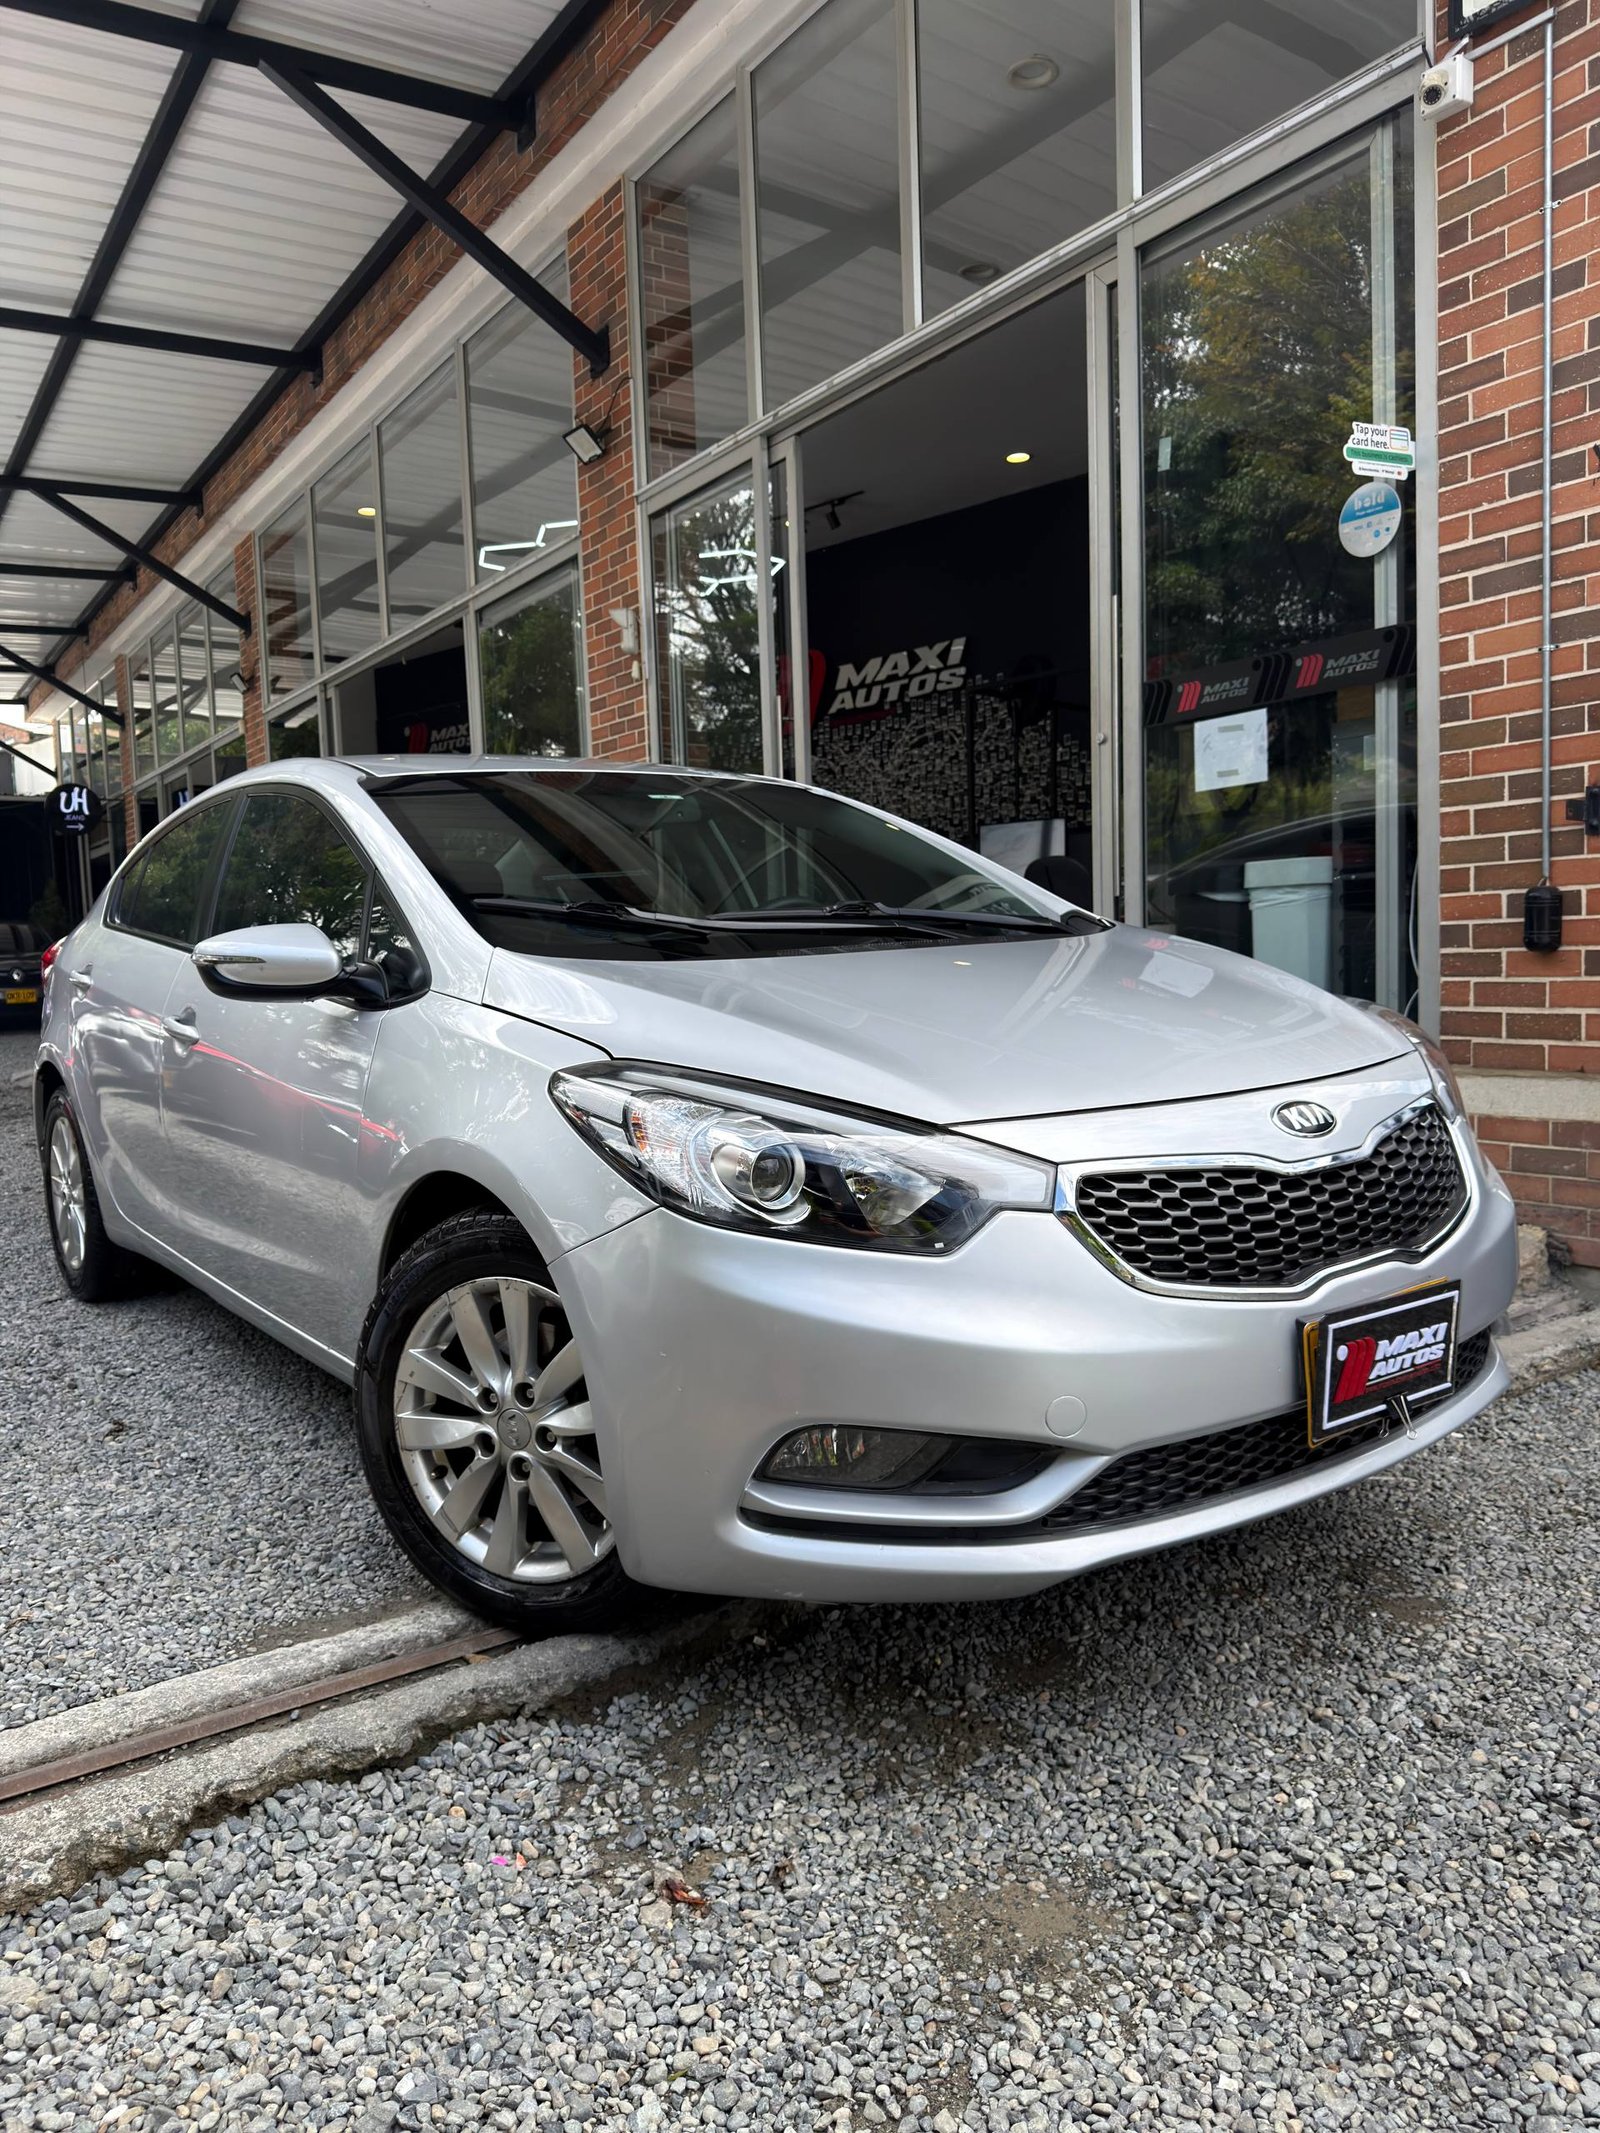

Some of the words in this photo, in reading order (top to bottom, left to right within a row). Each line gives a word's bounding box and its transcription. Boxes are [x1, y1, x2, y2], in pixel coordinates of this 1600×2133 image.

[1355, 423, 1369, 436] Tap
[1371, 427, 1388, 437] your
[1351, 437, 1369, 447] card
[1370, 438, 1390, 450] here.
[834, 636, 967, 692] MAXI
[1325, 649, 1381, 669] MAXI
[1323, 660, 1379, 679] AUTOS
[827, 666, 967, 715] AUTOS
[1201, 687, 1249, 704] AUTOS
[1203, 677, 1250, 695] MAXI
[431, 723, 469, 742] MAX
[1375, 1322, 1449, 1361] MAXI
[1368, 1343, 1447, 1380] AUTOS
